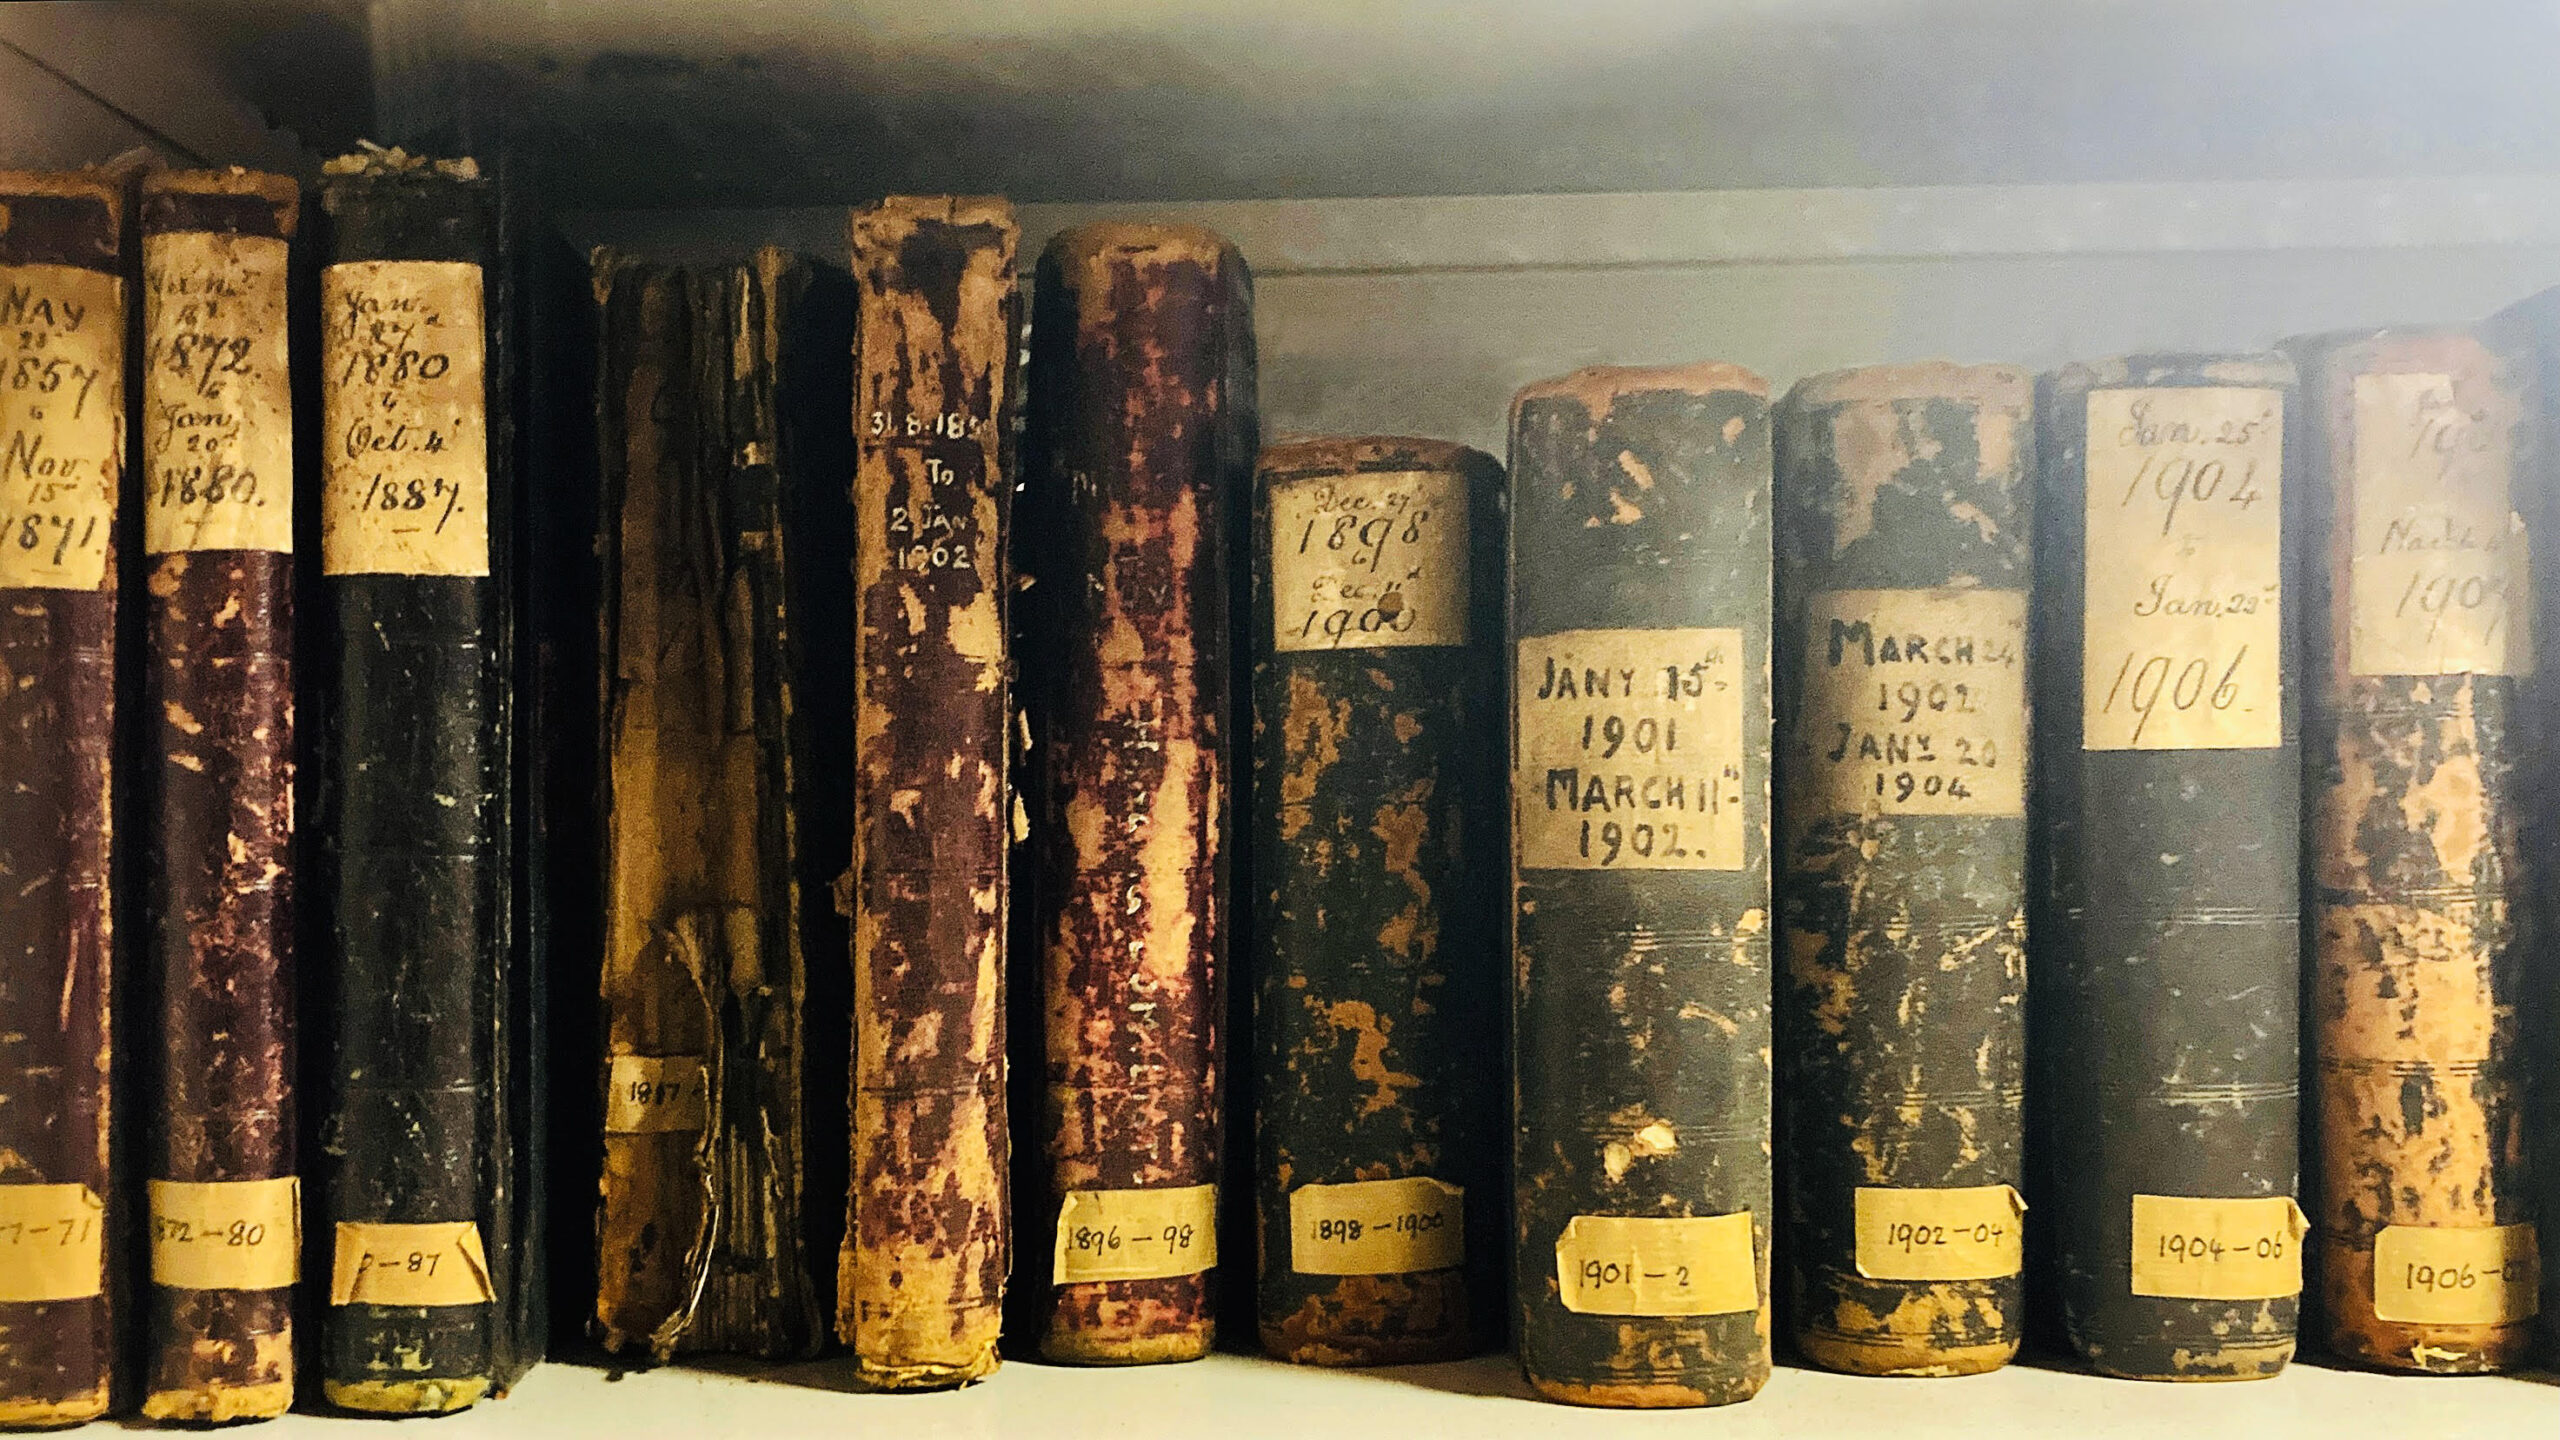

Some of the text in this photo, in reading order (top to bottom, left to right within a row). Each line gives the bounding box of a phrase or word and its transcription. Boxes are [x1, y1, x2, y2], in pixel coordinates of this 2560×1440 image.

[341, 350, 450, 388] 1880
[926, 458, 955, 486] To
[2122, 455, 2263, 537] 1904
[889, 507, 909, 532] 2
[897, 544, 972, 574] 1902
[1299, 510, 1430, 573] 1898
[1301, 608, 1417, 649] 1900
[1827, 618, 1974, 667] MARCH
[1877, 681, 1977, 723] 1902
[1581, 714, 1677, 760] 1901
[1546, 767, 1686, 814] MARCH
[1875, 771, 1972, 804] 1904
